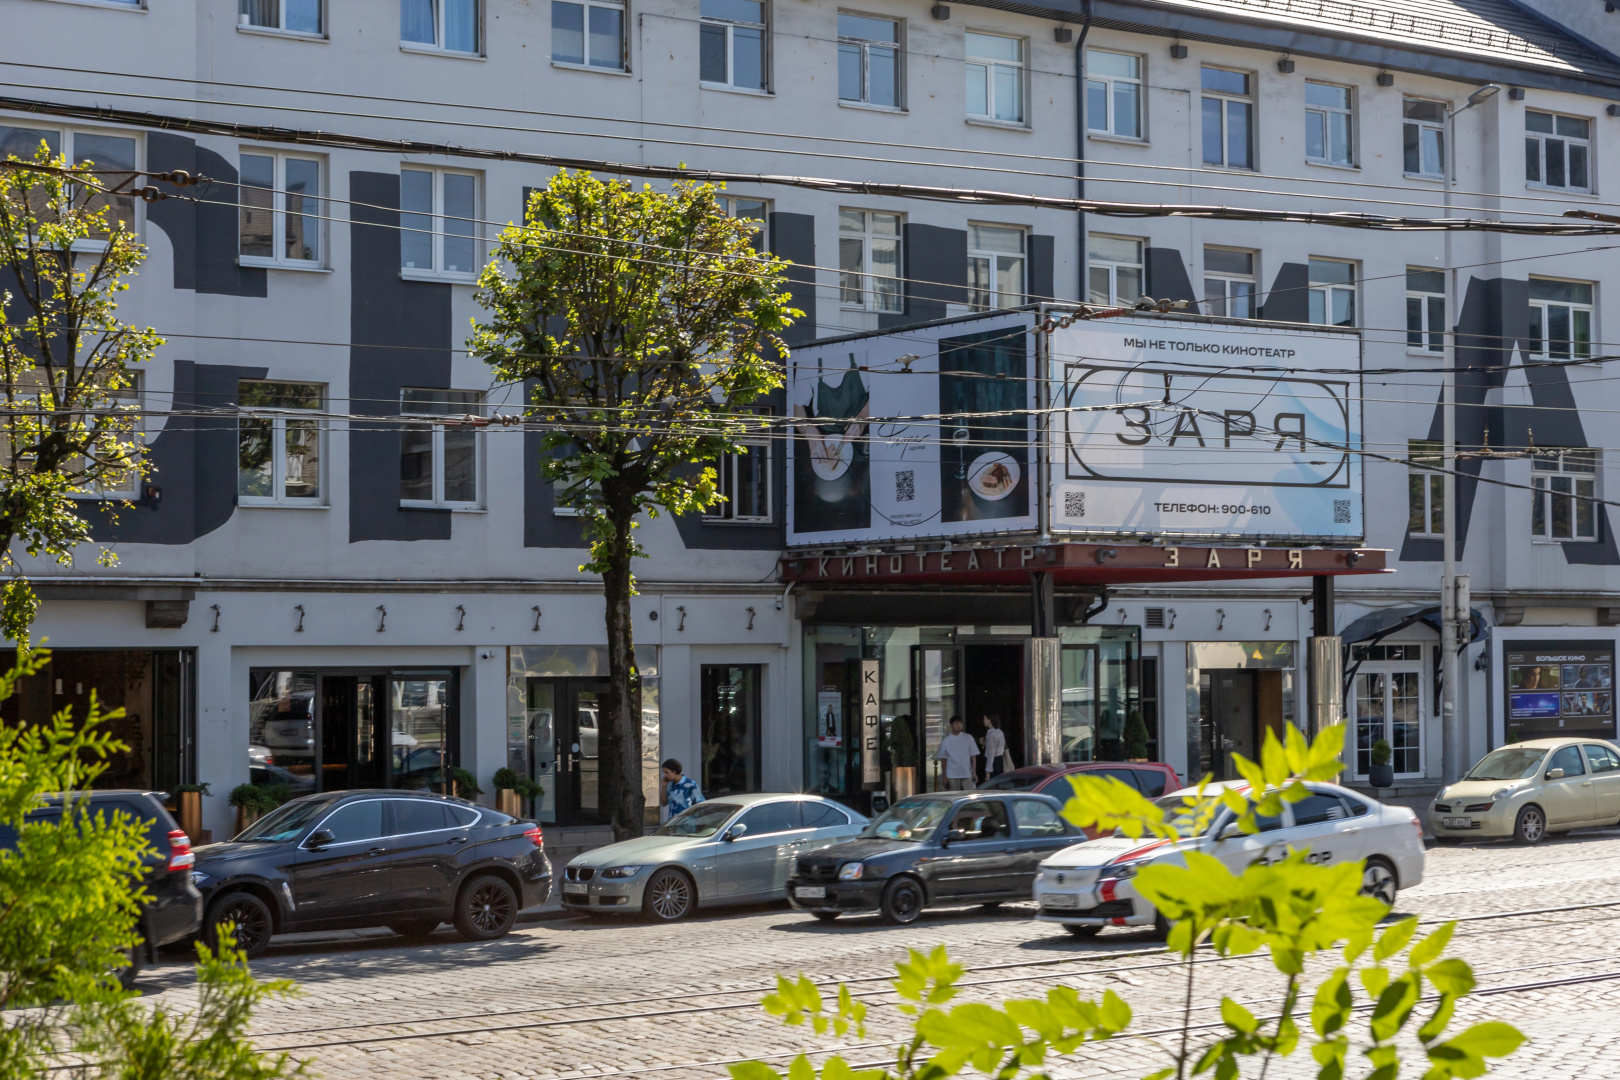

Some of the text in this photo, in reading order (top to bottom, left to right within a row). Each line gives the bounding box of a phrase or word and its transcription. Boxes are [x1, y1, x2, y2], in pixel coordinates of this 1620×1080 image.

[1123, 338, 1296, 359] МЫ НЕ ТОЛЬКО КИНОТЕАТР
[1115, 405, 1306, 453] ЗАРЯ
[1154, 502, 1271, 515] ТЕЛЕФОН: 900-610
[818, 547, 1303, 577] КИНОТЕАТР ЗАРЯ
[864, 670, 878, 751] КАФЕ
